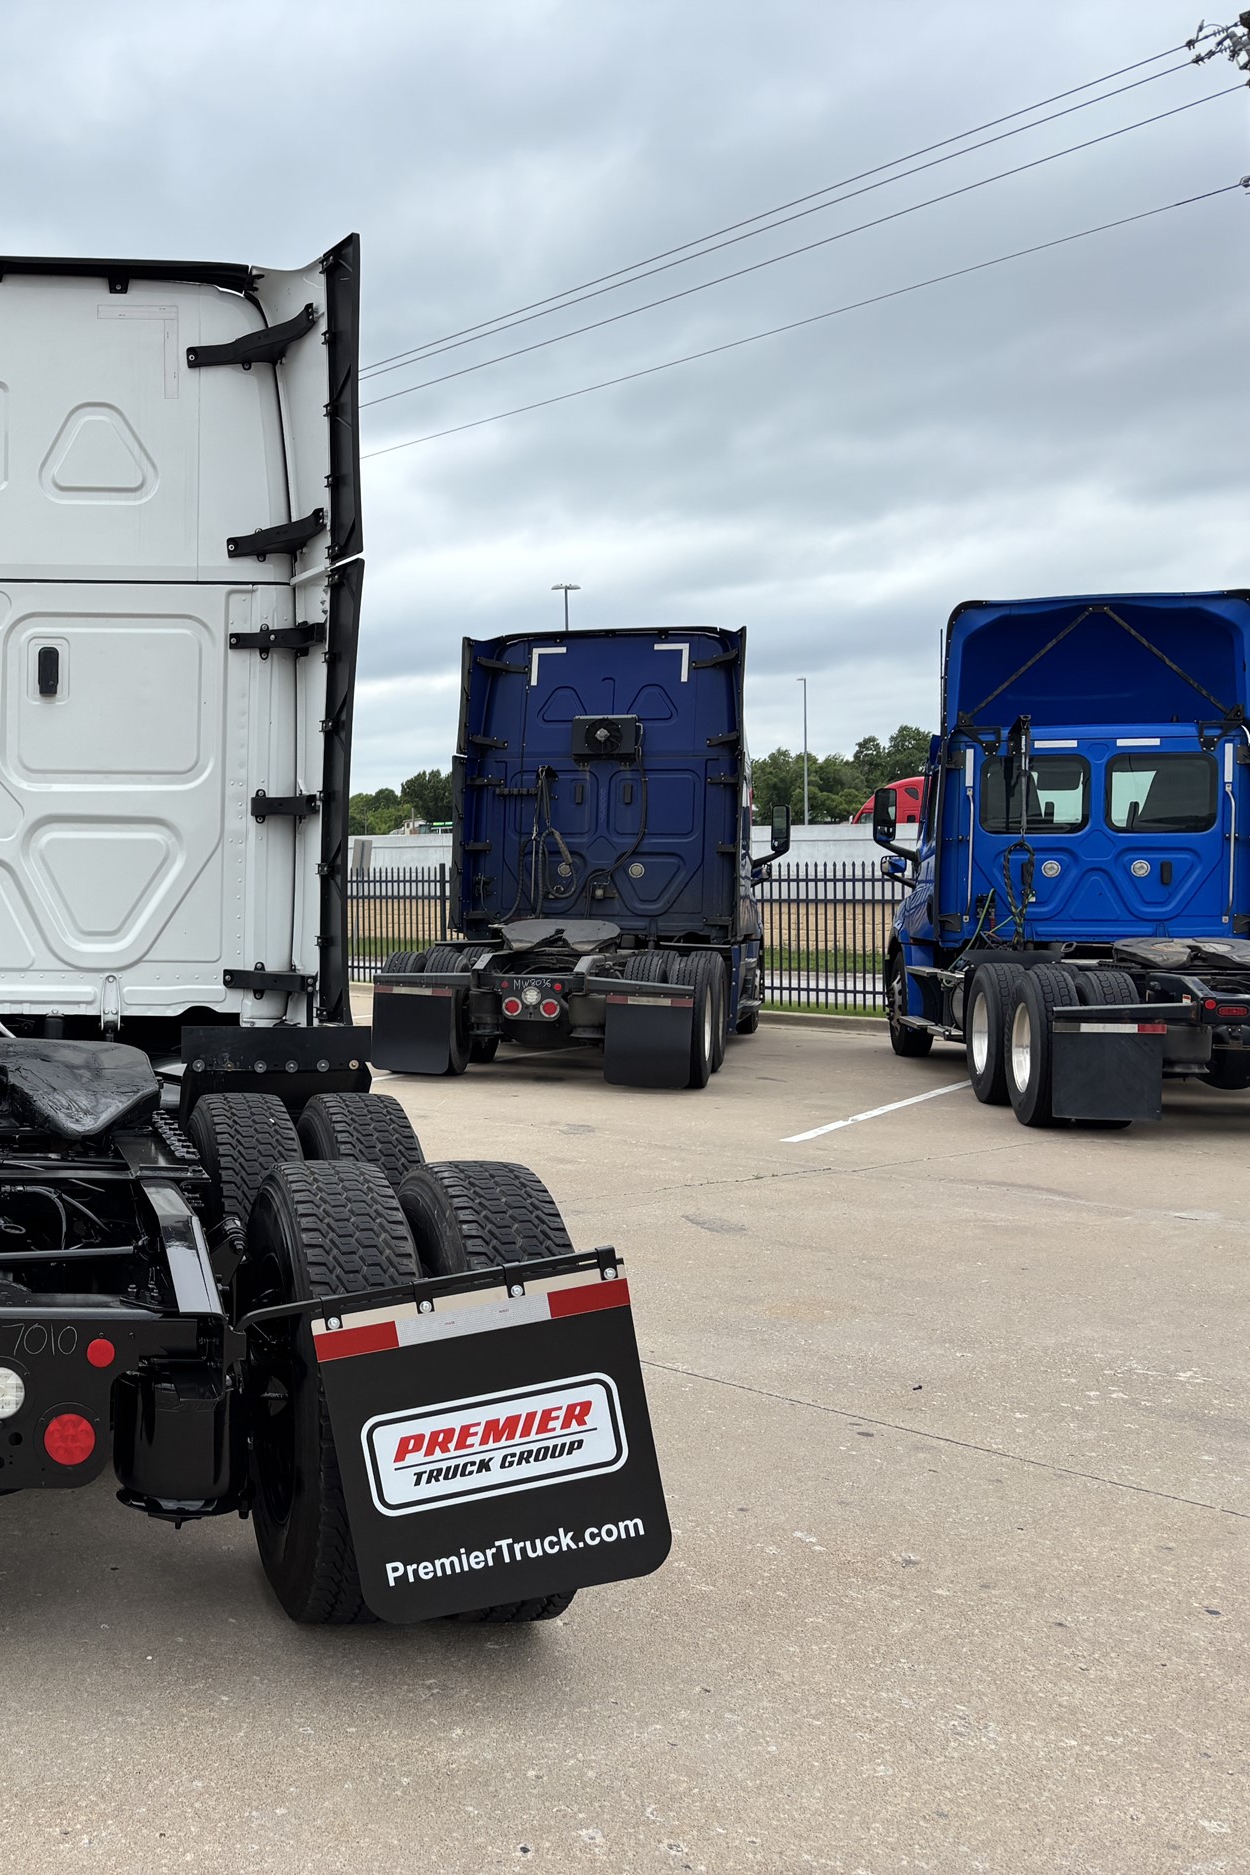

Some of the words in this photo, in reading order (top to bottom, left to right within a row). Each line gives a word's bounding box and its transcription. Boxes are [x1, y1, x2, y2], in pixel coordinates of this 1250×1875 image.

[393, 1400, 592, 1463] PREMIER
[412, 1455, 496, 1487] TRUCK
[499, 1438, 584, 1469] GROUP
[385, 1516, 645, 1587] PremierTruck.com
